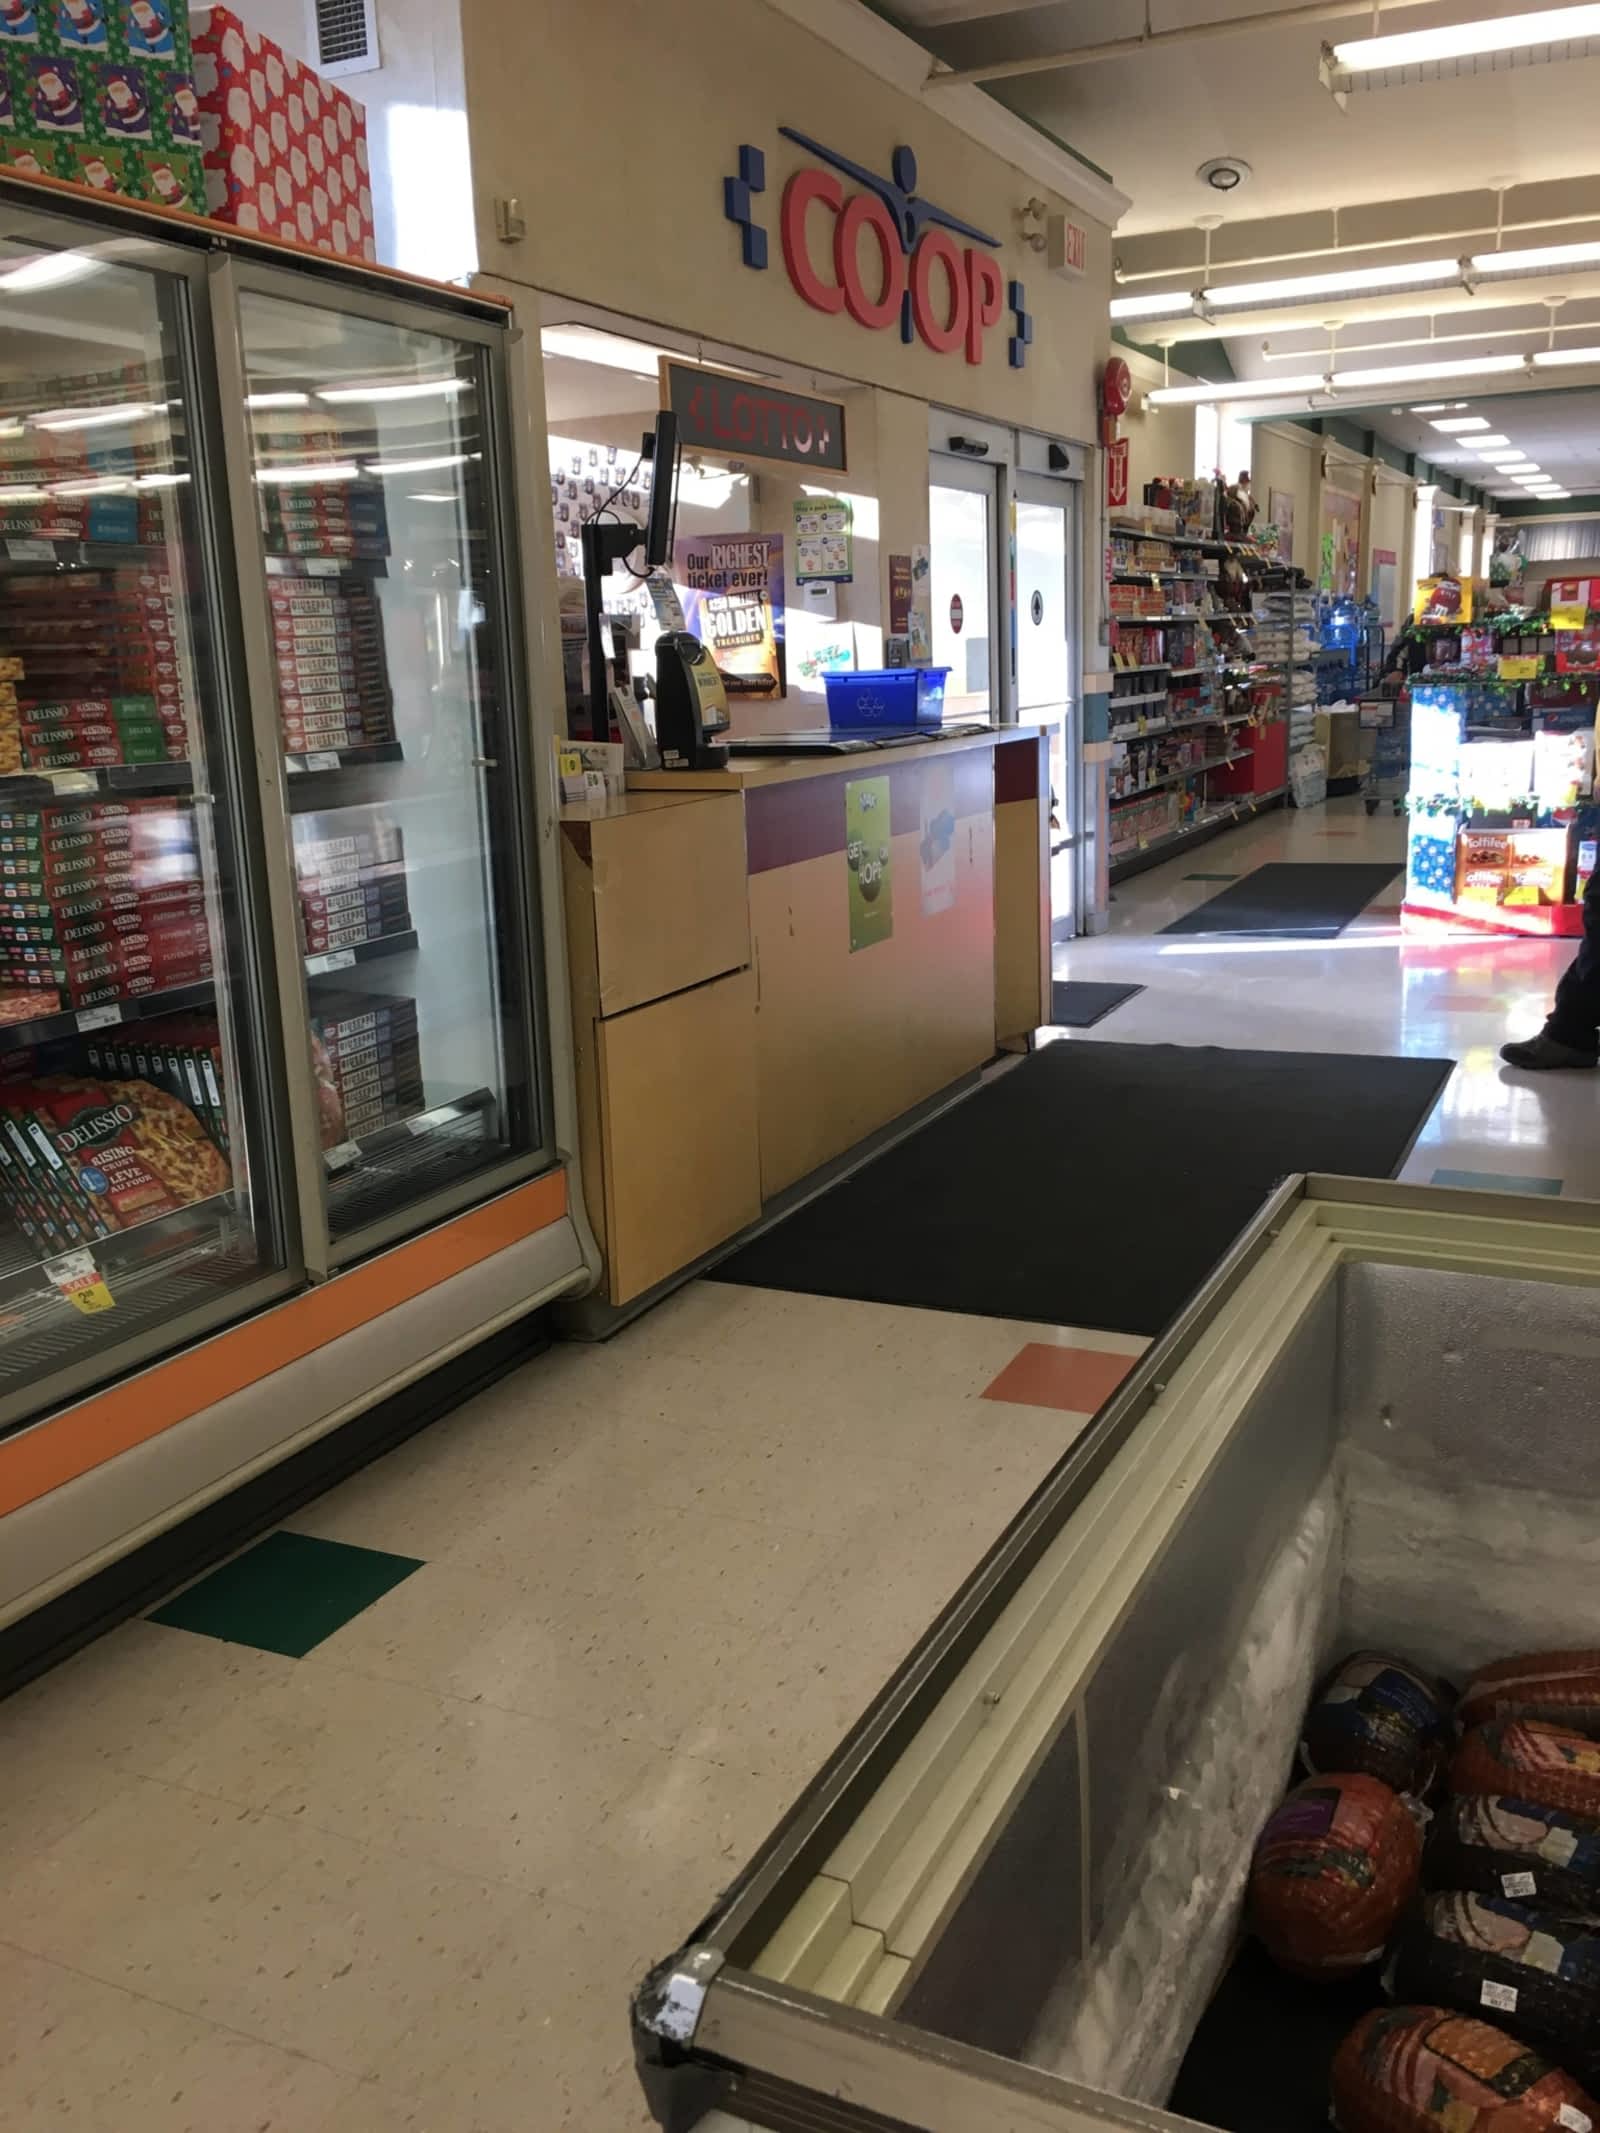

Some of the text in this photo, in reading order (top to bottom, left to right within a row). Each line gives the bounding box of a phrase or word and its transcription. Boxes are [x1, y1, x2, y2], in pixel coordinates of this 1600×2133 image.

[1066, 223, 1086, 270] EXIT
[711, 385, 813, 453] LOTTO
[687, 542, 771, 571] Our RICHEST
[688, 569, 768, 589] ticket ever!
[291, 599, 332, 612] GIUSEPPE
[293, 618, 335, 631] GIUSEPPE
[705, 605, 768, 638] GOLDEN
[302, 694, 343, 708] GIUSEPPE
[26, 705, 70, 722] DELISSIO
[304, 713, 345, 727] GIUSEPPE
[31, 729, 74, 745] DELISSIO
[307, 732, 347, 747] GIUSEPPE
[51, 810, 92, 828] DELISSIO
[51, 833, 93, 851] DELISSIO
[847, 840, 864, 860] GET
[1467, 837, 1508, 849] Toffifee
[53, 856, 96, 874] DELISSIO
[53, 879, 97, 898] DELISSIO
[328, 890, 365, 907] GIUSEPPE
[60, 899, 103, 919] DELISSIO
[329, 908, 366, 925] GIUSEPPE
[63, 921, 105, 941] DELISSIO
[329, 926, 367, 944] GIUSEPPE
[71, 942, 113, 962] DELISSIO
[76, 964, 117, 984] DELISSIO
[80, 985, 120, 1006] DELISSIO
[340, 1013, 375, 1033] GIUSEPPE
[340, 1031, 375, 1051] GIUSEPPE
[341, 1048, 378, 1071] GIUSEPPE
[57, 1104, 134, 1152] DELISSIO
[90, 1146, 136, 1167] RISING
[102, 1156, 135, 1172] CRUST
[111, 1174, 153, 1194] AU FOUR
[66, 1276, 93, 1292] SALE
